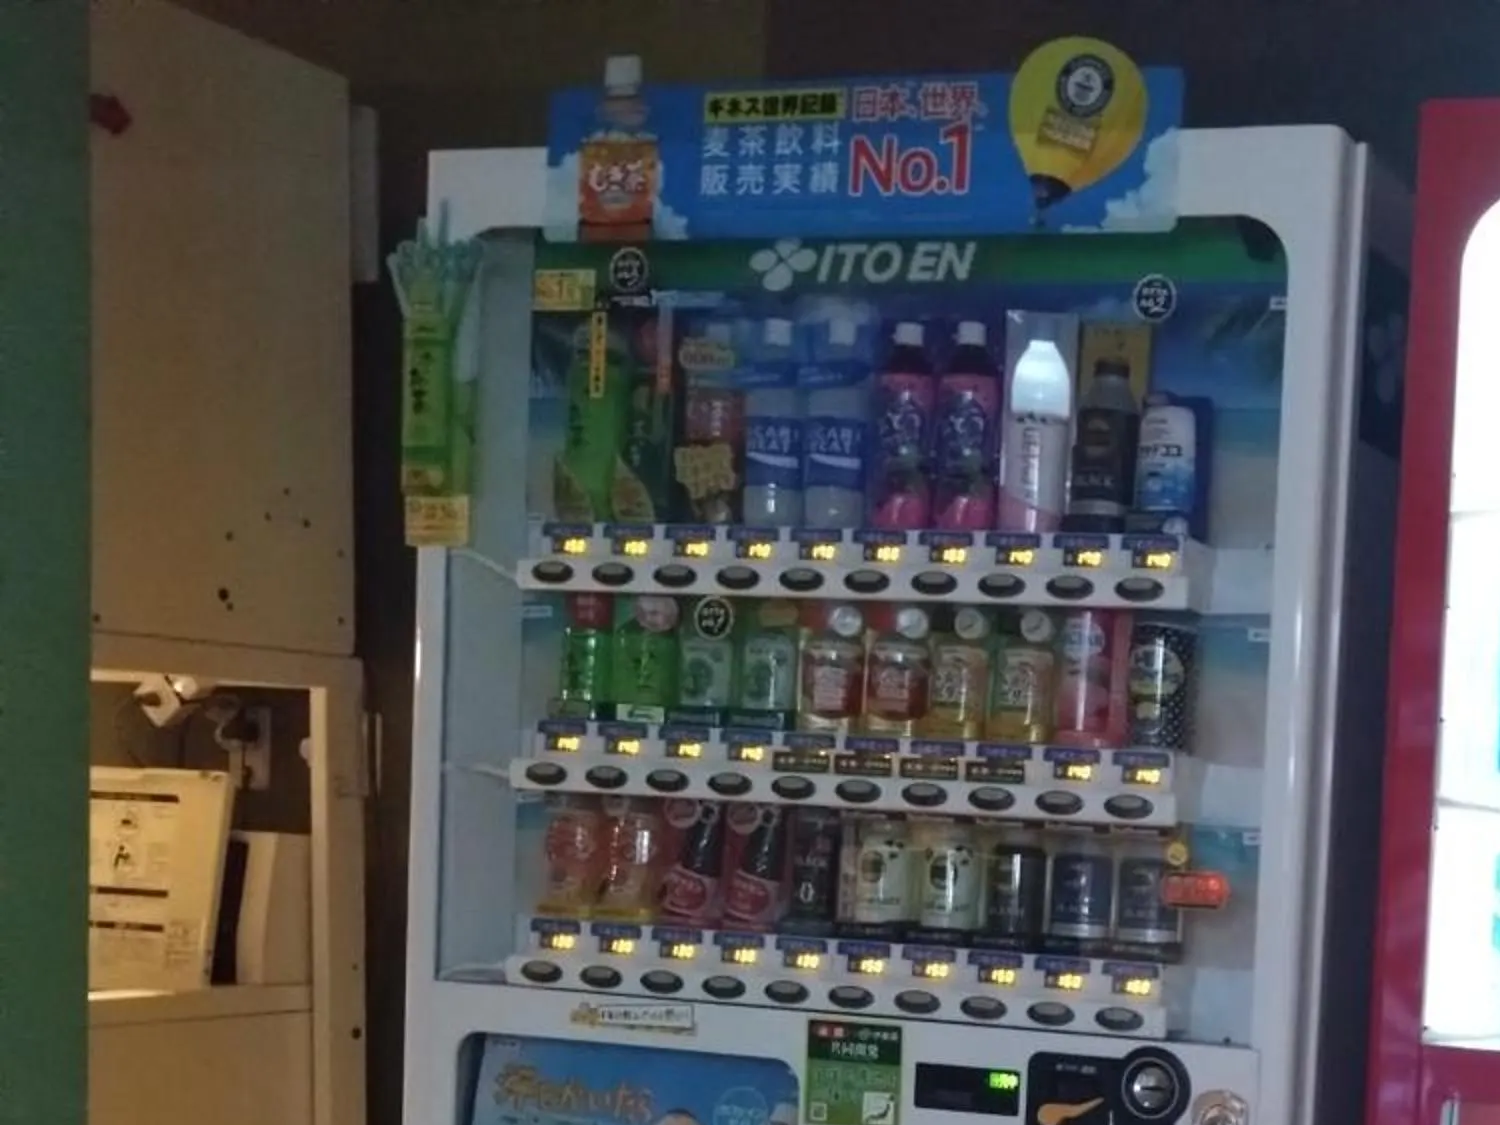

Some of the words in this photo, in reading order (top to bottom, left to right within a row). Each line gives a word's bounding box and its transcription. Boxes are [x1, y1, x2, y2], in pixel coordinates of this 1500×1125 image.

[703, 123, 841, 157] 麦茶飲料
[849, 122, 972, 196] No.1
[816, 244, 903, 283] ITO
[908, 242, 975, 280] EN
